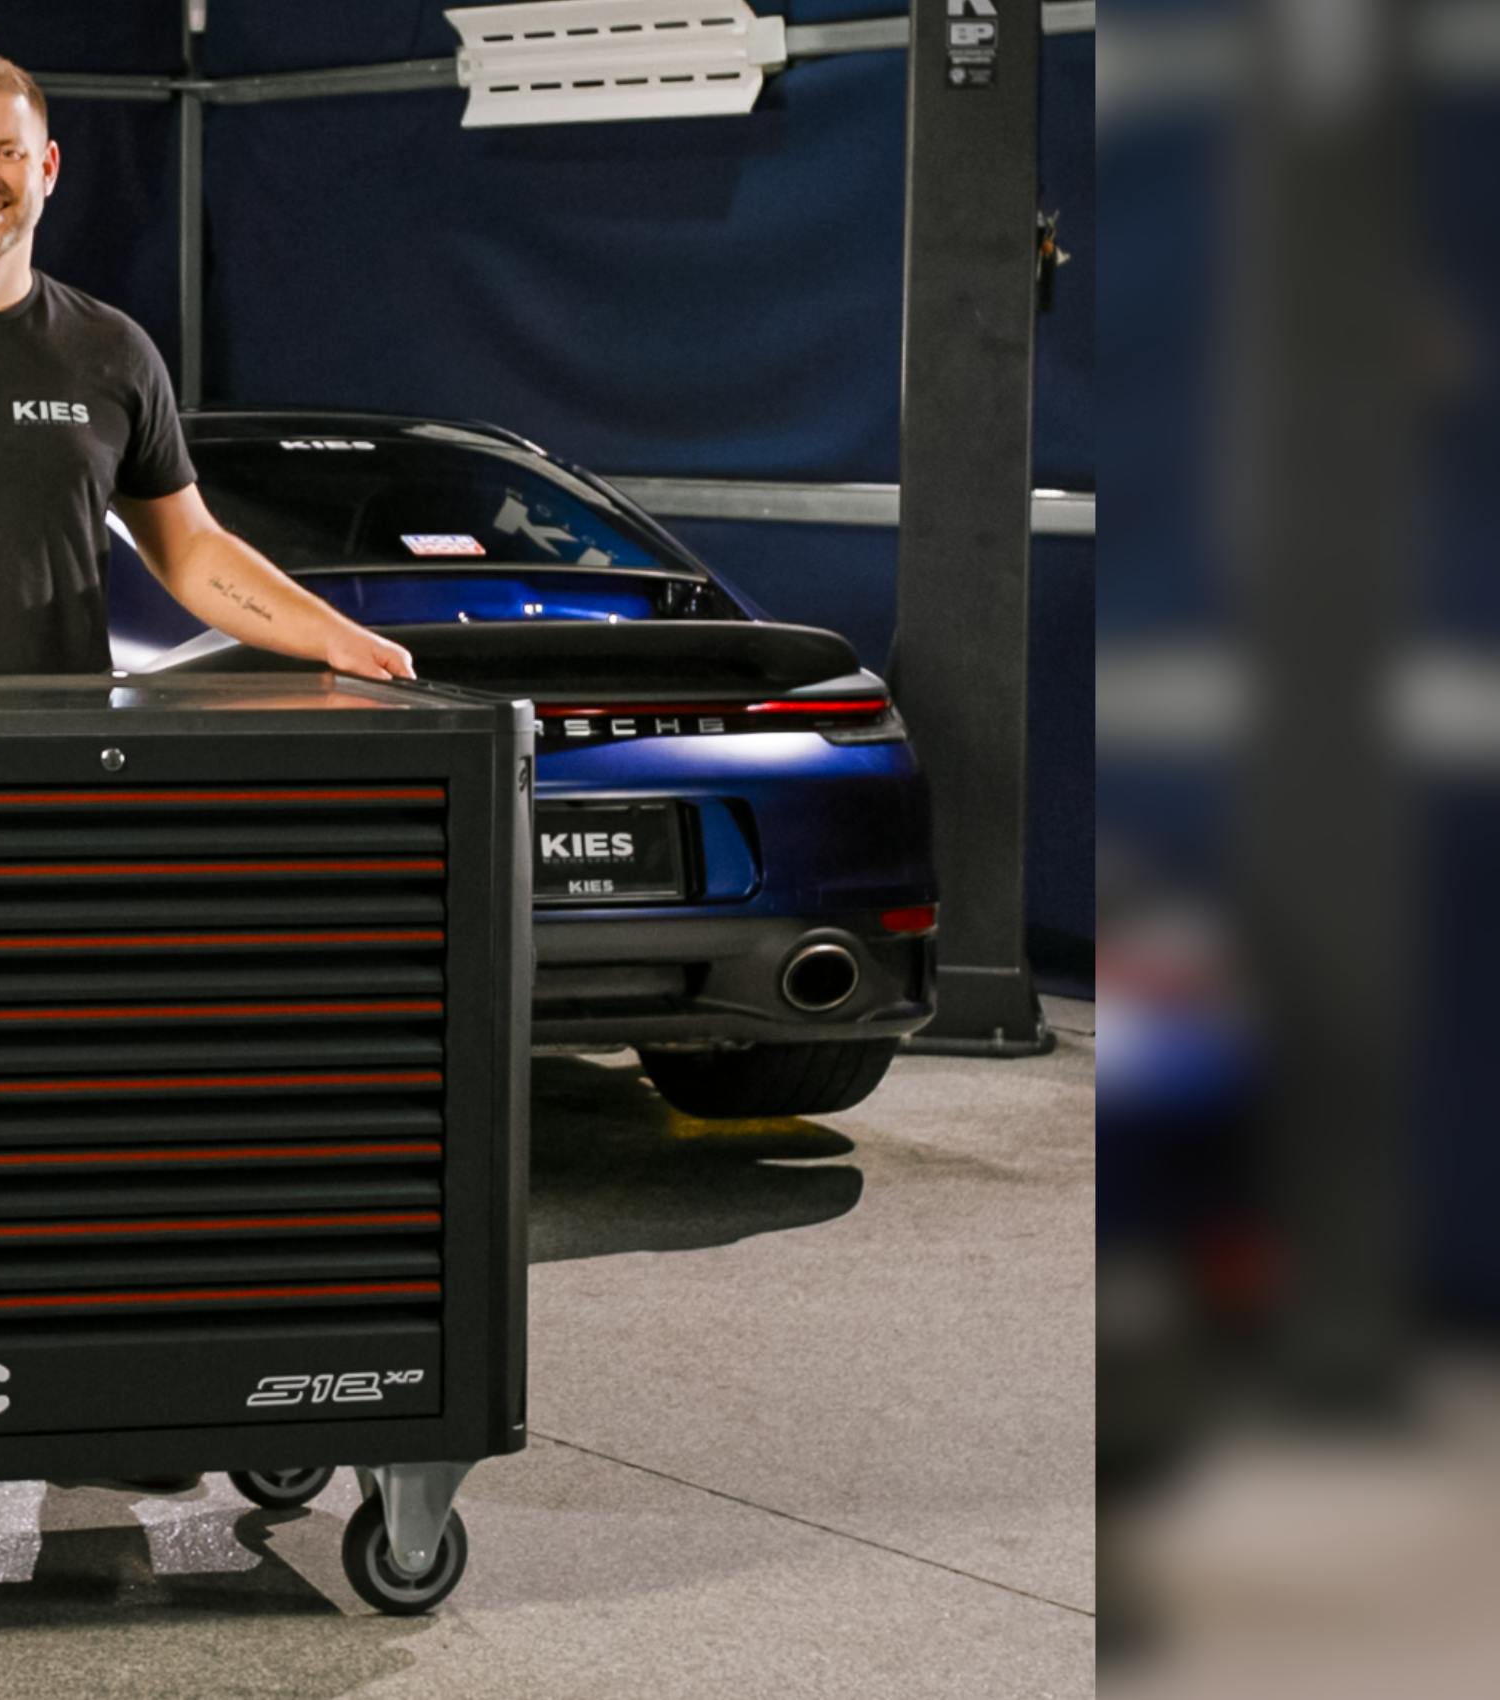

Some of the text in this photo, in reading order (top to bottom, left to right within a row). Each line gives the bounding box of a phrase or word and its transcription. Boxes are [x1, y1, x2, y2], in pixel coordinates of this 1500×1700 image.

[13, 400, 89, 424] KIES
[541, 832, 634, 858] KIES
[568, 880, 614, 894] KIES
